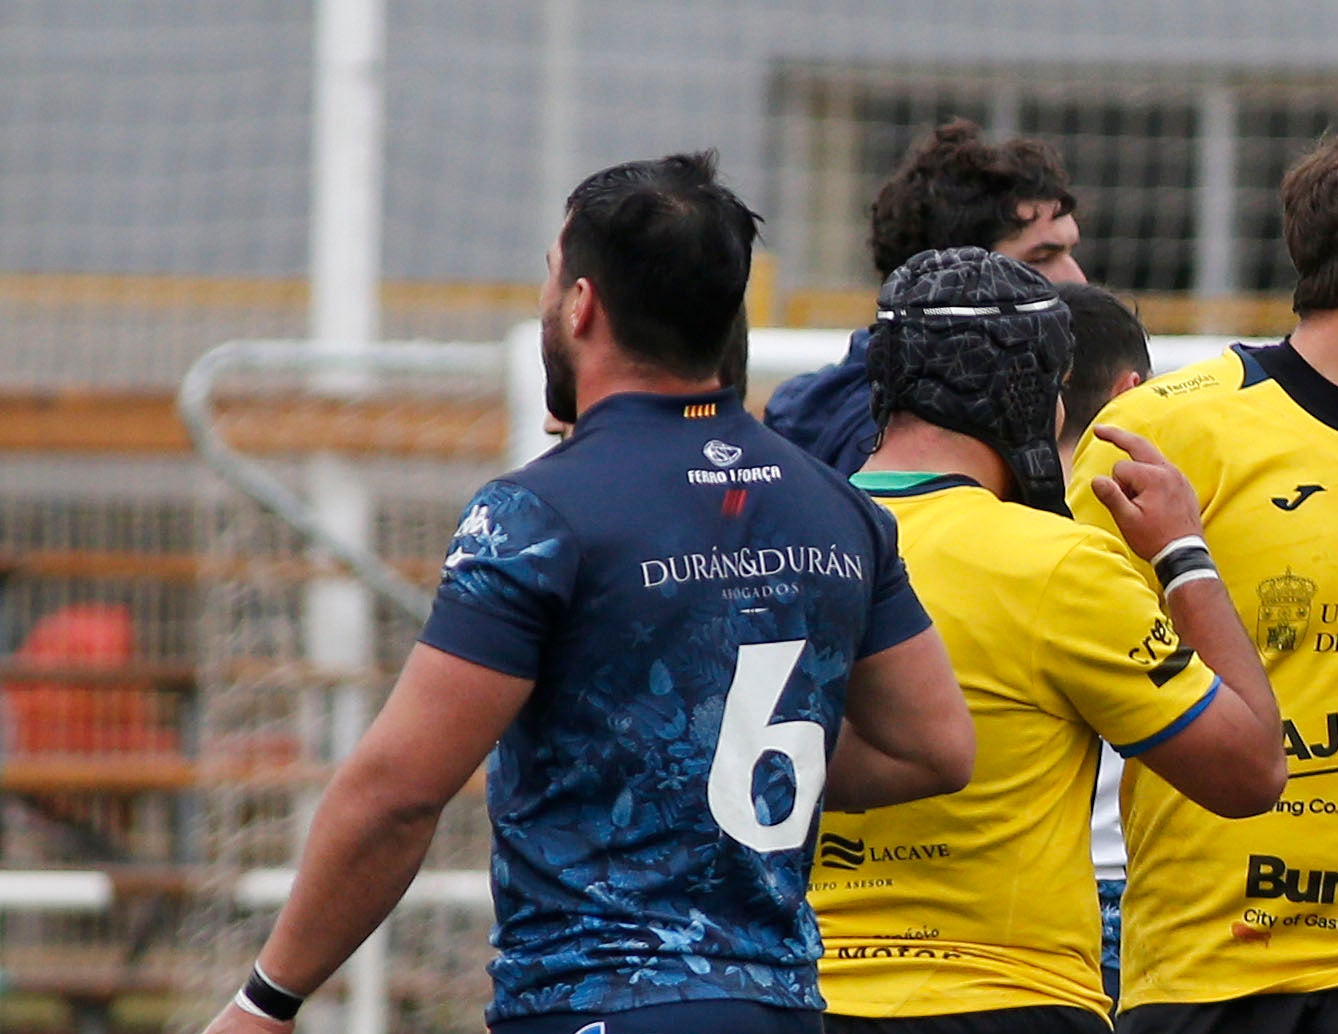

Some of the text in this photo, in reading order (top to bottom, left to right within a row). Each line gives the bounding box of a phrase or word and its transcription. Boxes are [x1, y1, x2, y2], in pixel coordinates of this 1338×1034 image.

[687, 469, 727, 485] FERRO
[737, 465, 782, 483] FORÇA
[640, 544, 863, 588] DURÁN&DURÁN
[707, 639, 827, 853] 6
[1309, 798, 1338, 814] Co.
[869, 843, 950, 862] LACAVE
[845, 878, 894, 890] ASESOR
[1243, 908, 1278, 928] City
[1282, 913, 1302, 927] of
